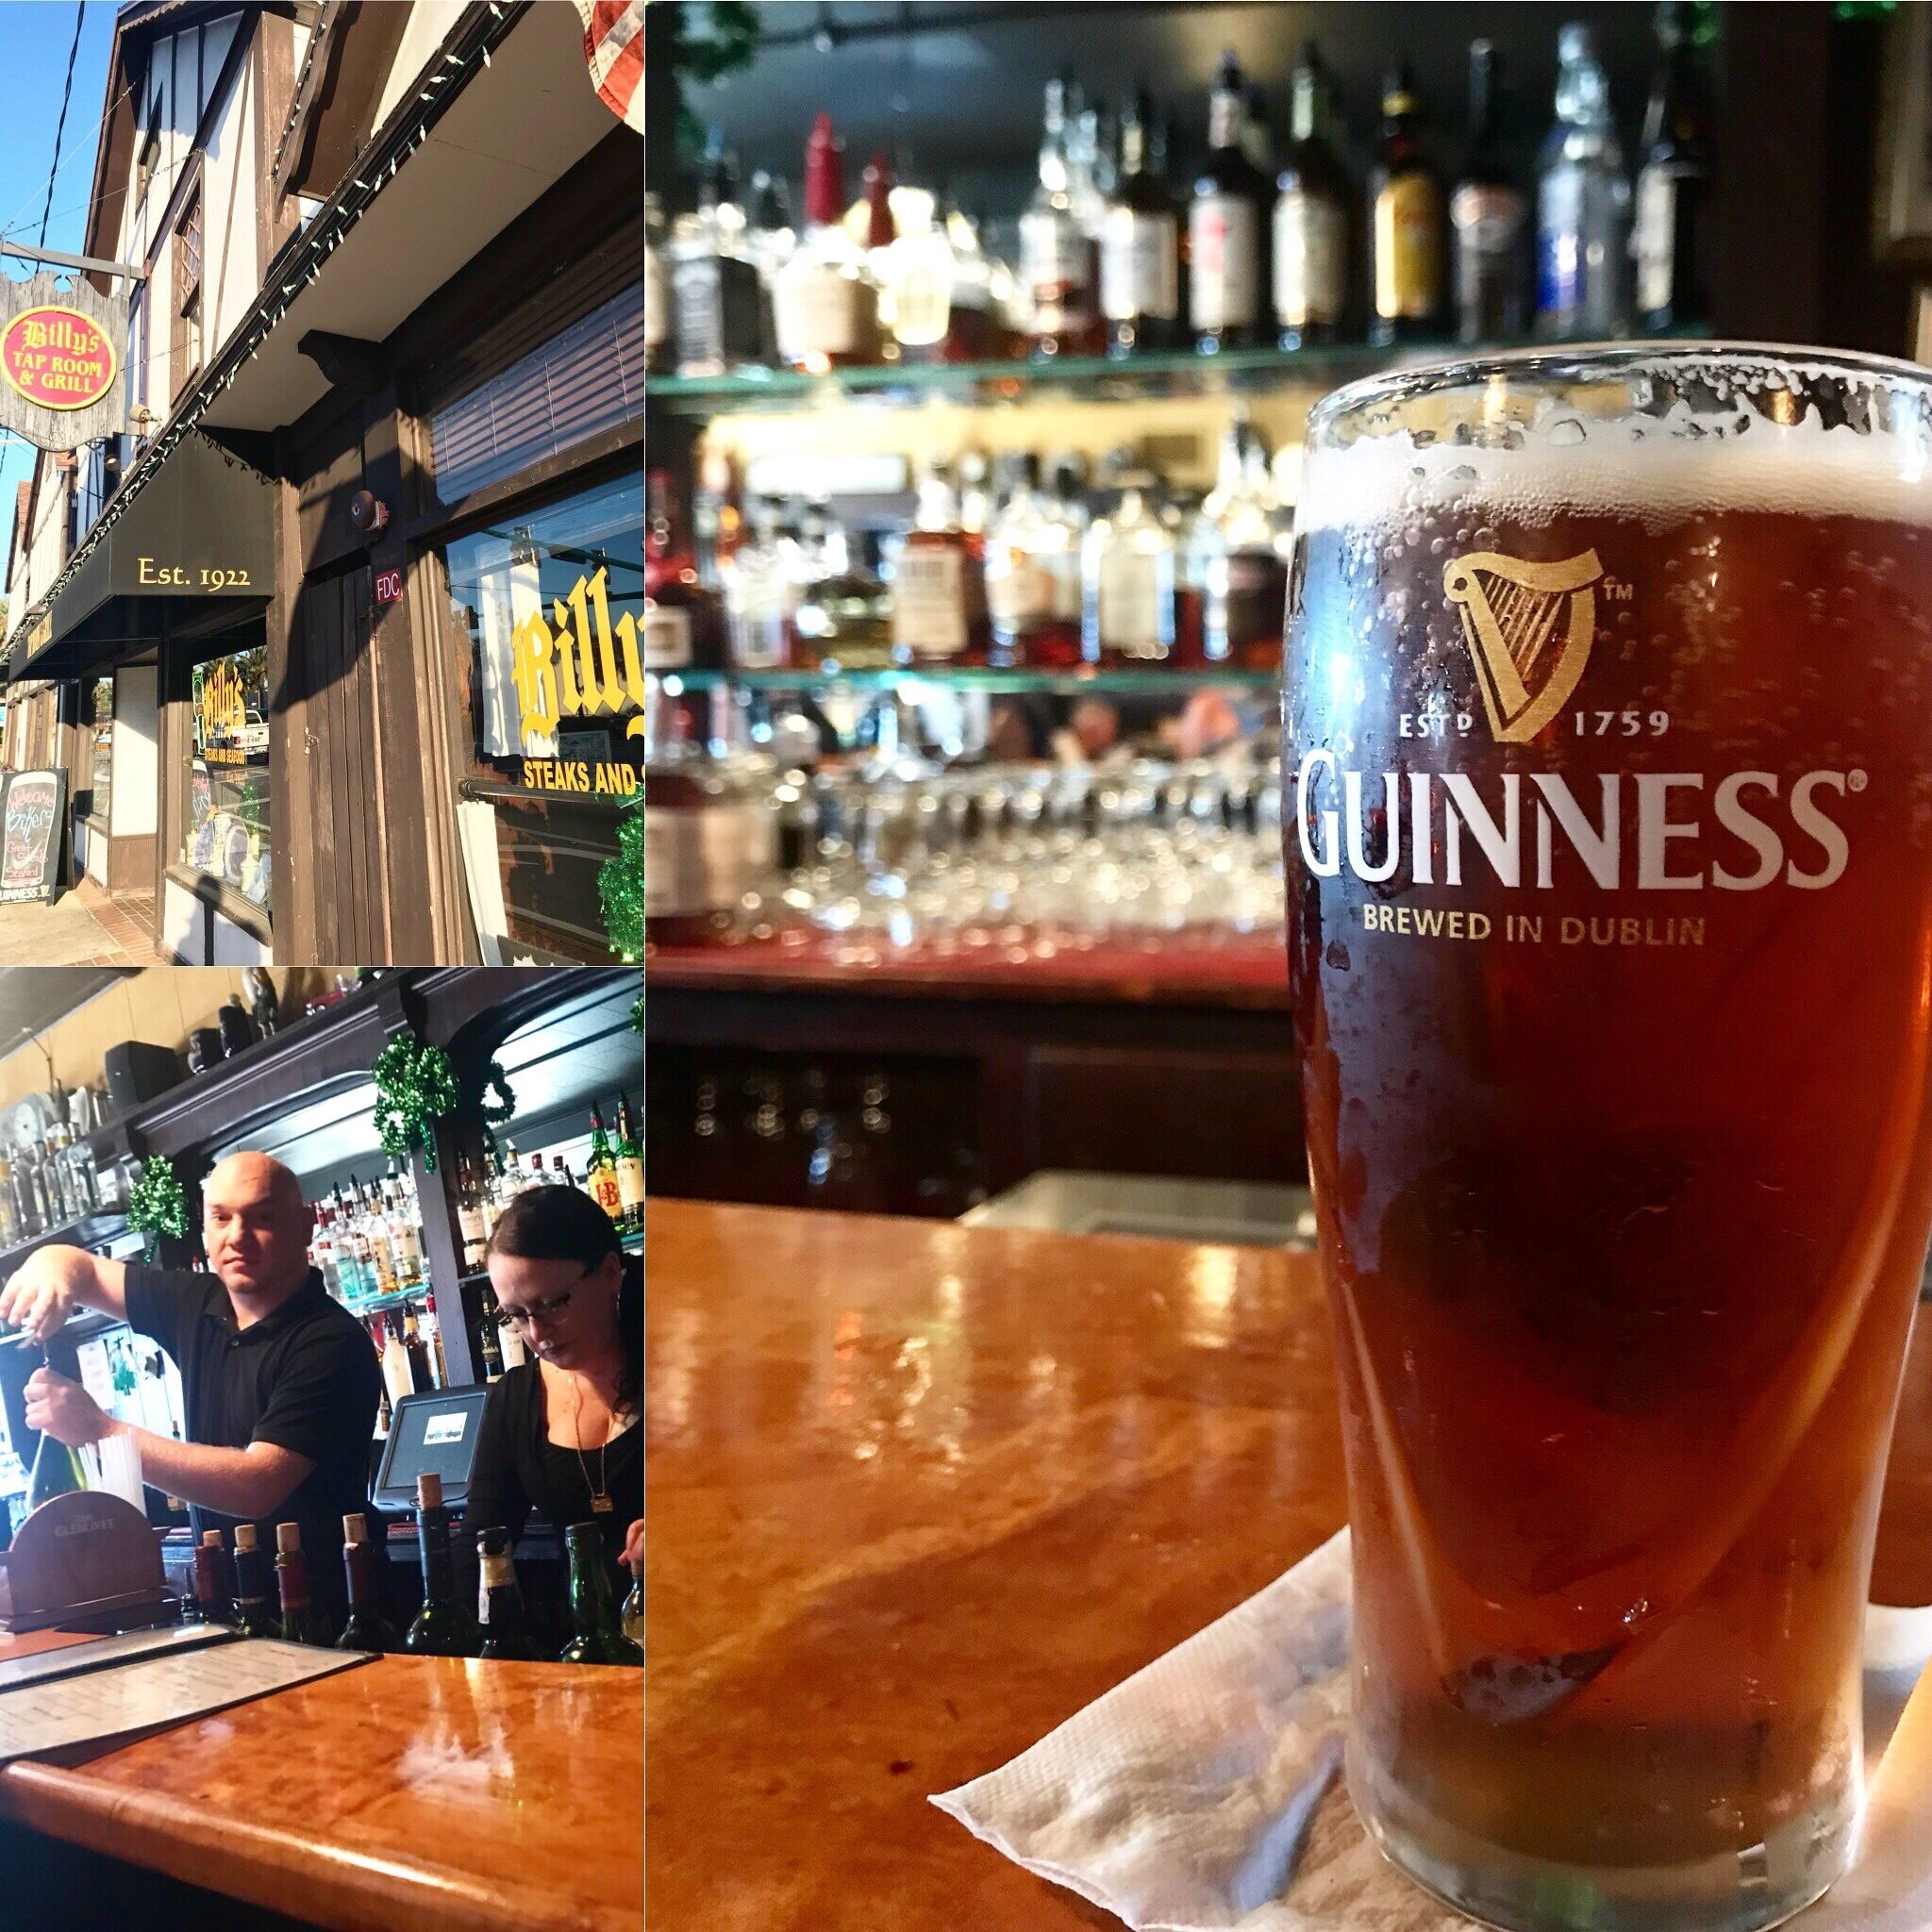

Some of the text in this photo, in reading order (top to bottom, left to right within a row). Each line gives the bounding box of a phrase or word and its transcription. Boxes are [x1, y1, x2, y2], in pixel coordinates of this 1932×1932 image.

[22, 320, 100, 357] Billy's
[13, 351, 102, 378] TAP ROOM
[20, 369, 93, 393] & GRILL
[138, 558, 251, 592] Est. 1922
[376, 573, 400, 601] FDC
[1603, 583, 1633, 601] TM
[1575, 710, 1671, 738] 1759
[524, 760, 591, 792] STEAKS
[595, 762, 637, 795] AND
[1297, 748, 1850, 891] GUINNESS
[1363, 903, 1706, 945] BREWED IN DUBLIN
